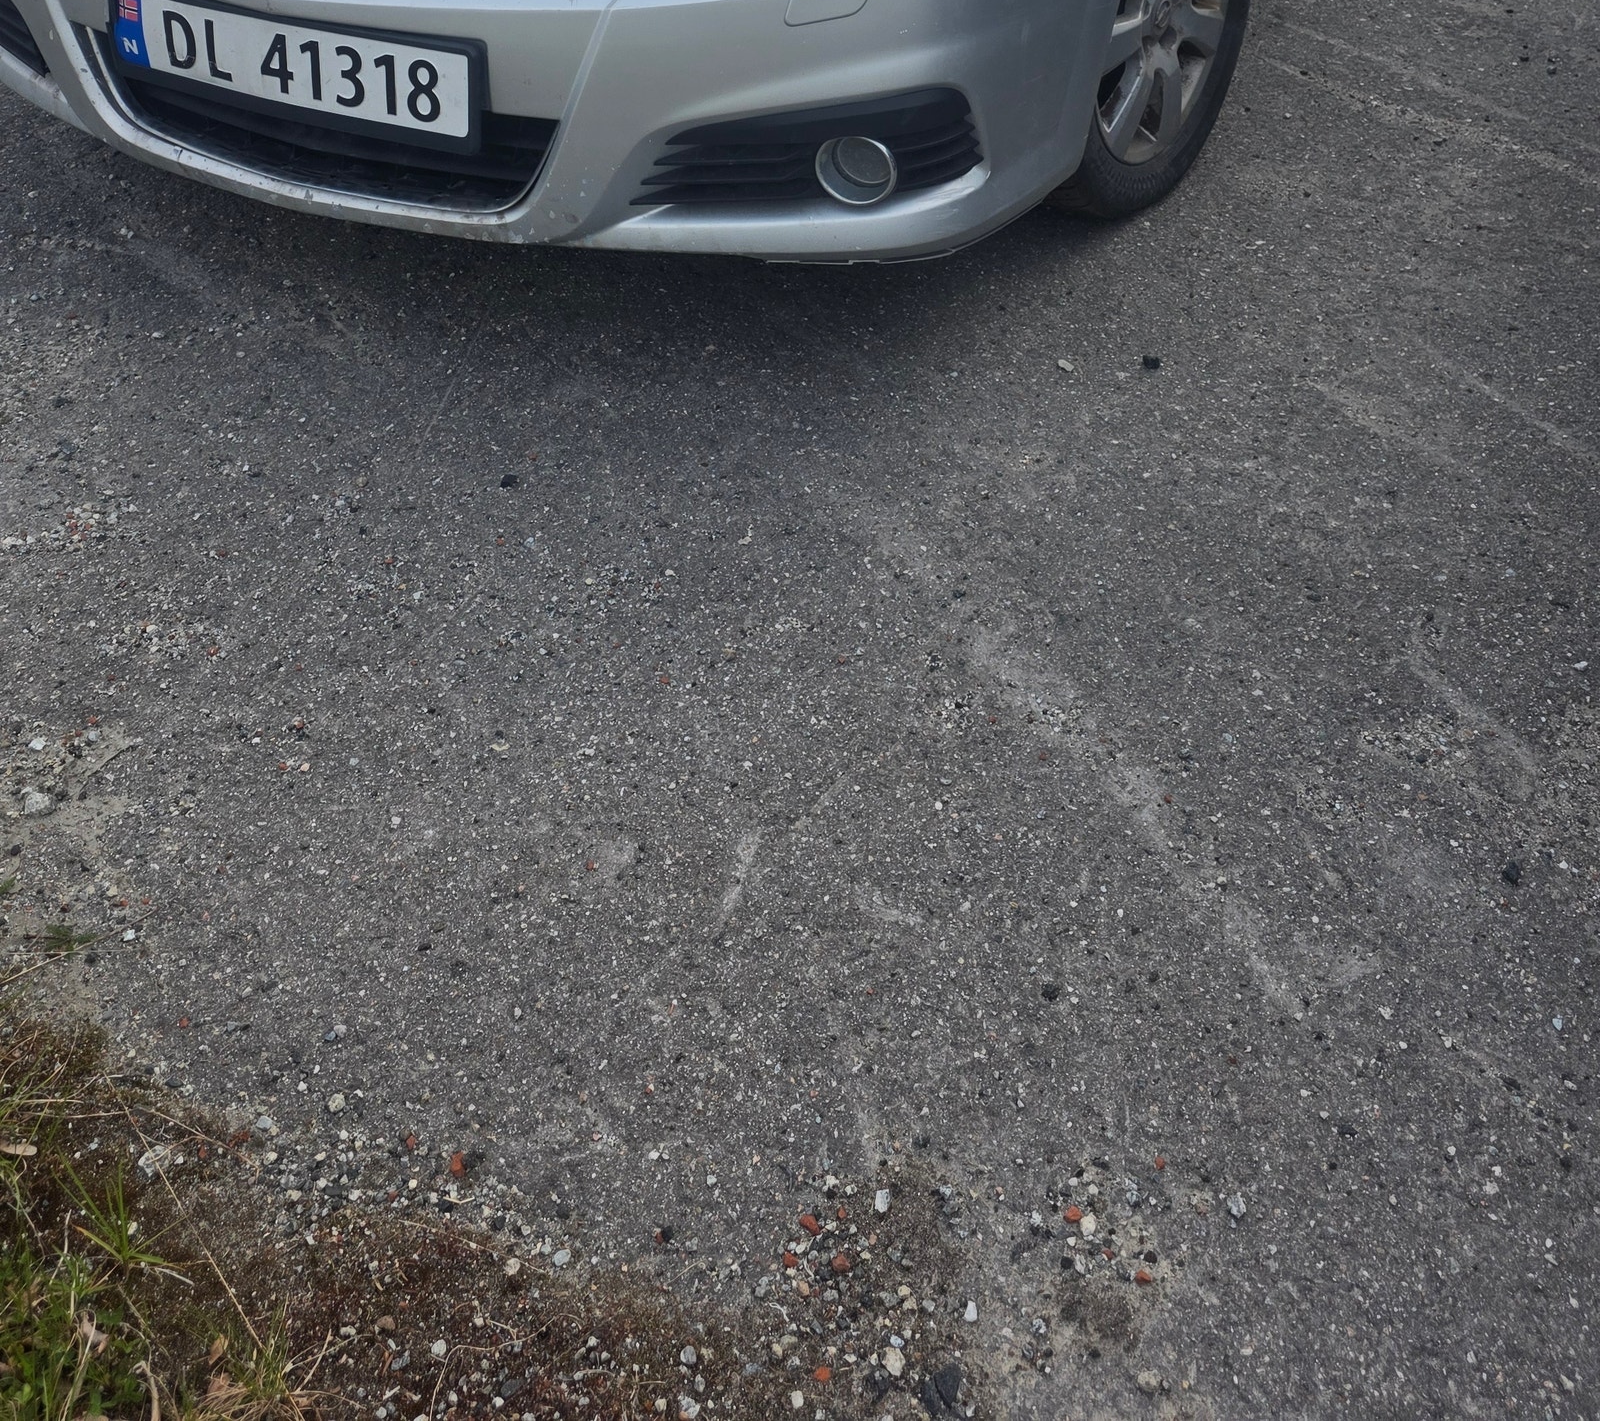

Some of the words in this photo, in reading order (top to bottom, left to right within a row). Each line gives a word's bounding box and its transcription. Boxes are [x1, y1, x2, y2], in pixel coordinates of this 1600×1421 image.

[121, 37, 139, 55] N
[162, 10, 233, 83] DL
[260, 33, 441, 123] 41318
